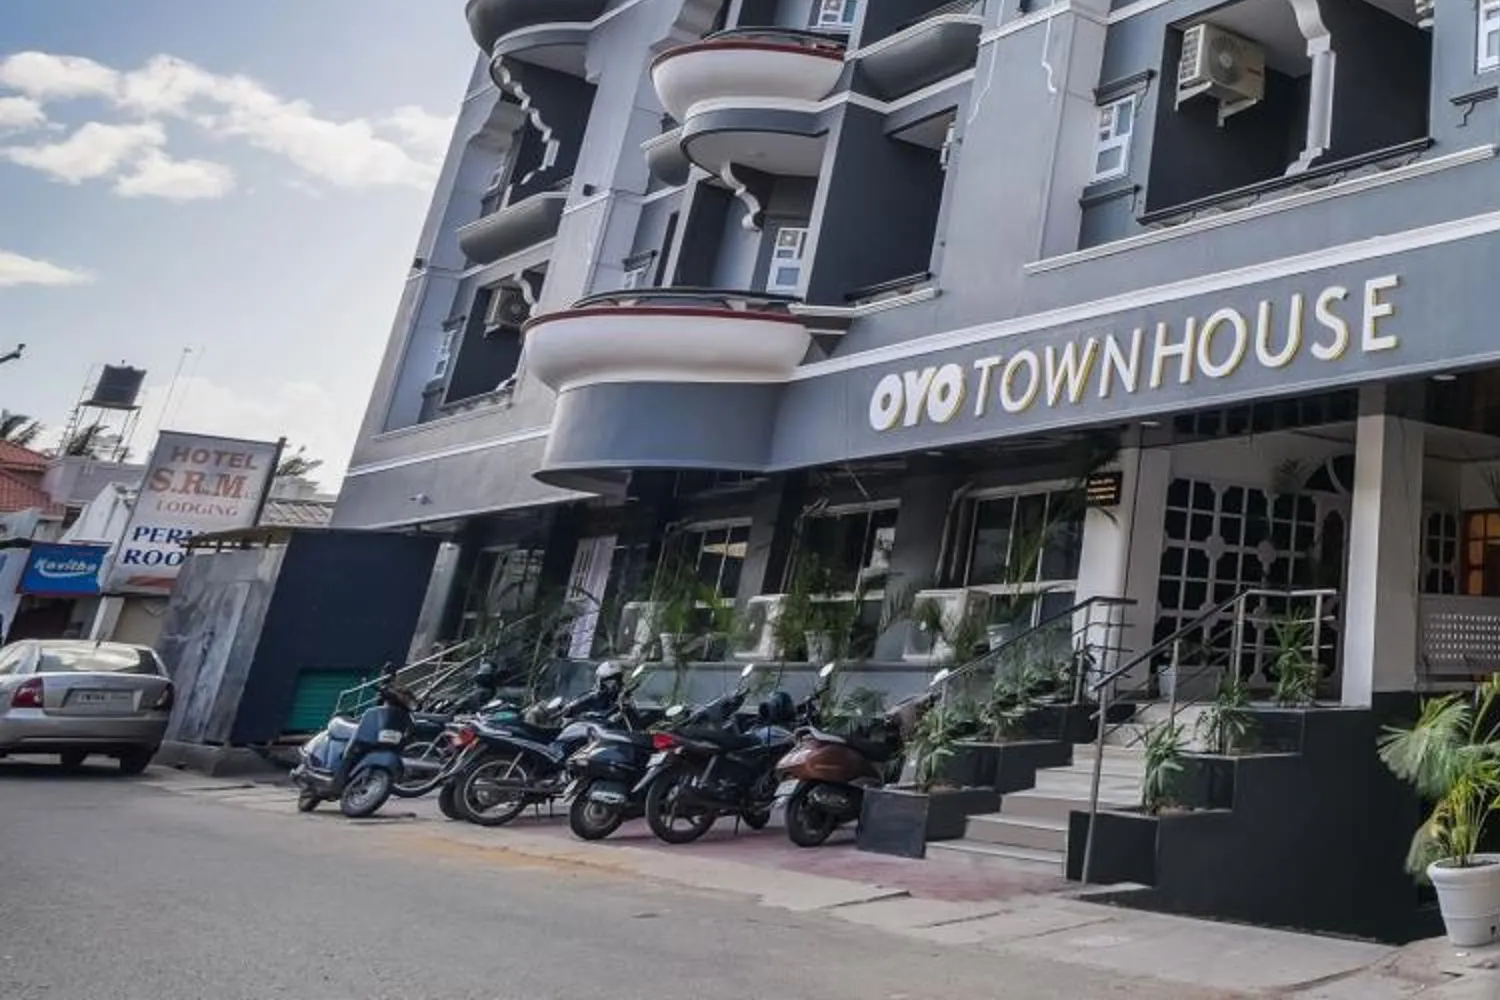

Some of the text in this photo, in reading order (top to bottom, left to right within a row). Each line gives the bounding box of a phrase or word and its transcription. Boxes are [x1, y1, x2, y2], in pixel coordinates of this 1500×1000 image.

[869, 274, 1399, 431] OYO TOWNHOUSE
[170, 446, 258, 470] HOTEL
[156, 500, 238, 517] LODGING
[123, 549, 186, 566] ROO
